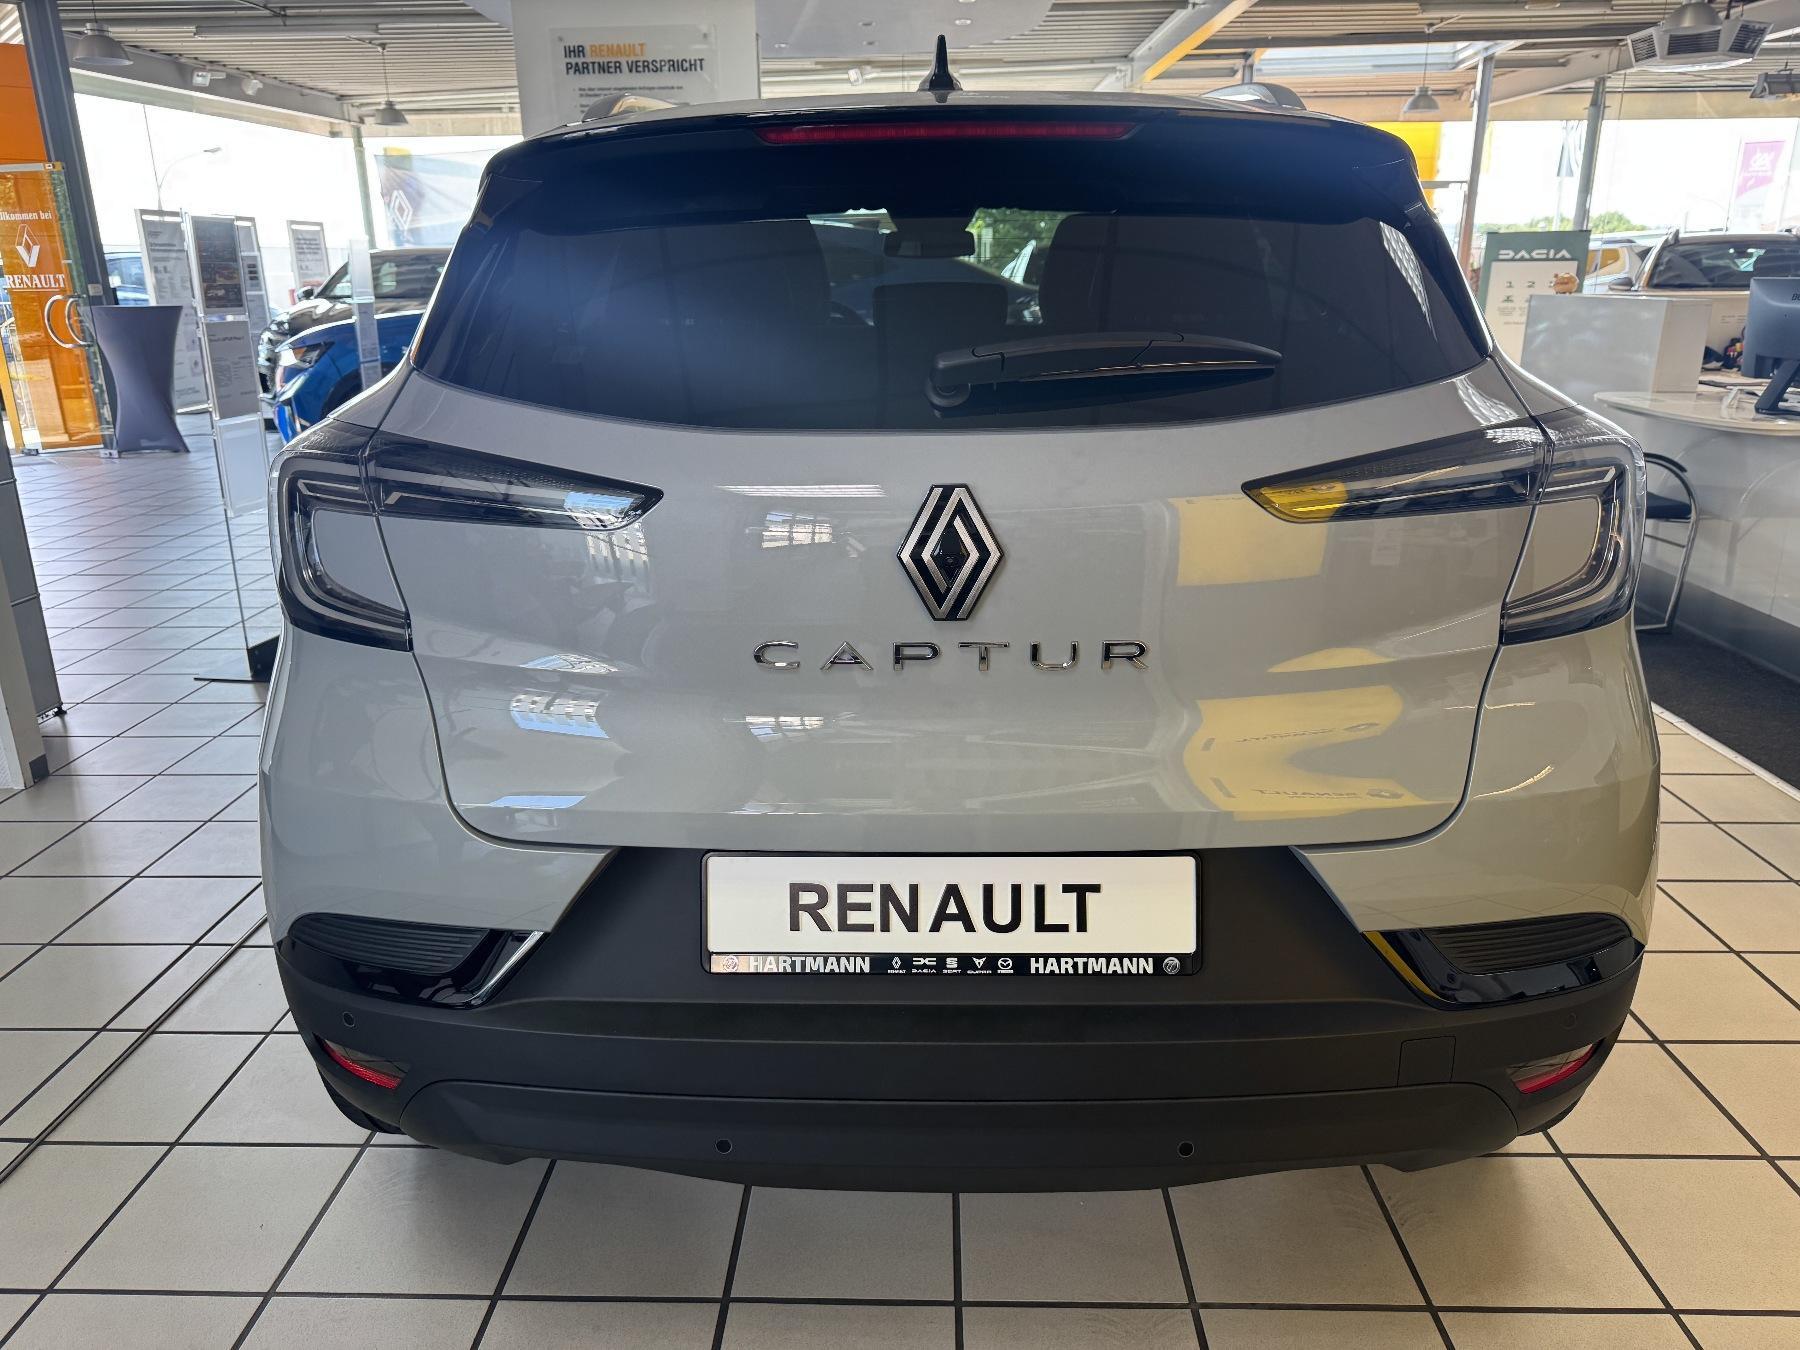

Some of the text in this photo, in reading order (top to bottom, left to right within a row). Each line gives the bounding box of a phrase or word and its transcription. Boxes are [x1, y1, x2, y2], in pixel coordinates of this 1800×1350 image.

[564, 43, 646, 58] IHR RENAULT
[565, 58, 705, 75] PARTNER VERSPRICHT
[0, 210, 52, 221] llkommen bei
[1498, 249, 1572, 259] DACIA
[3, 273, 65, 289] RENAULT
[752, 640, 1149, 672] CAPTUR
[789, 882, 1101, 933] RENAULT
[750, 956, 870, 973] HARTMANN
[1030, 957, 1154, 974] HARTMANN
